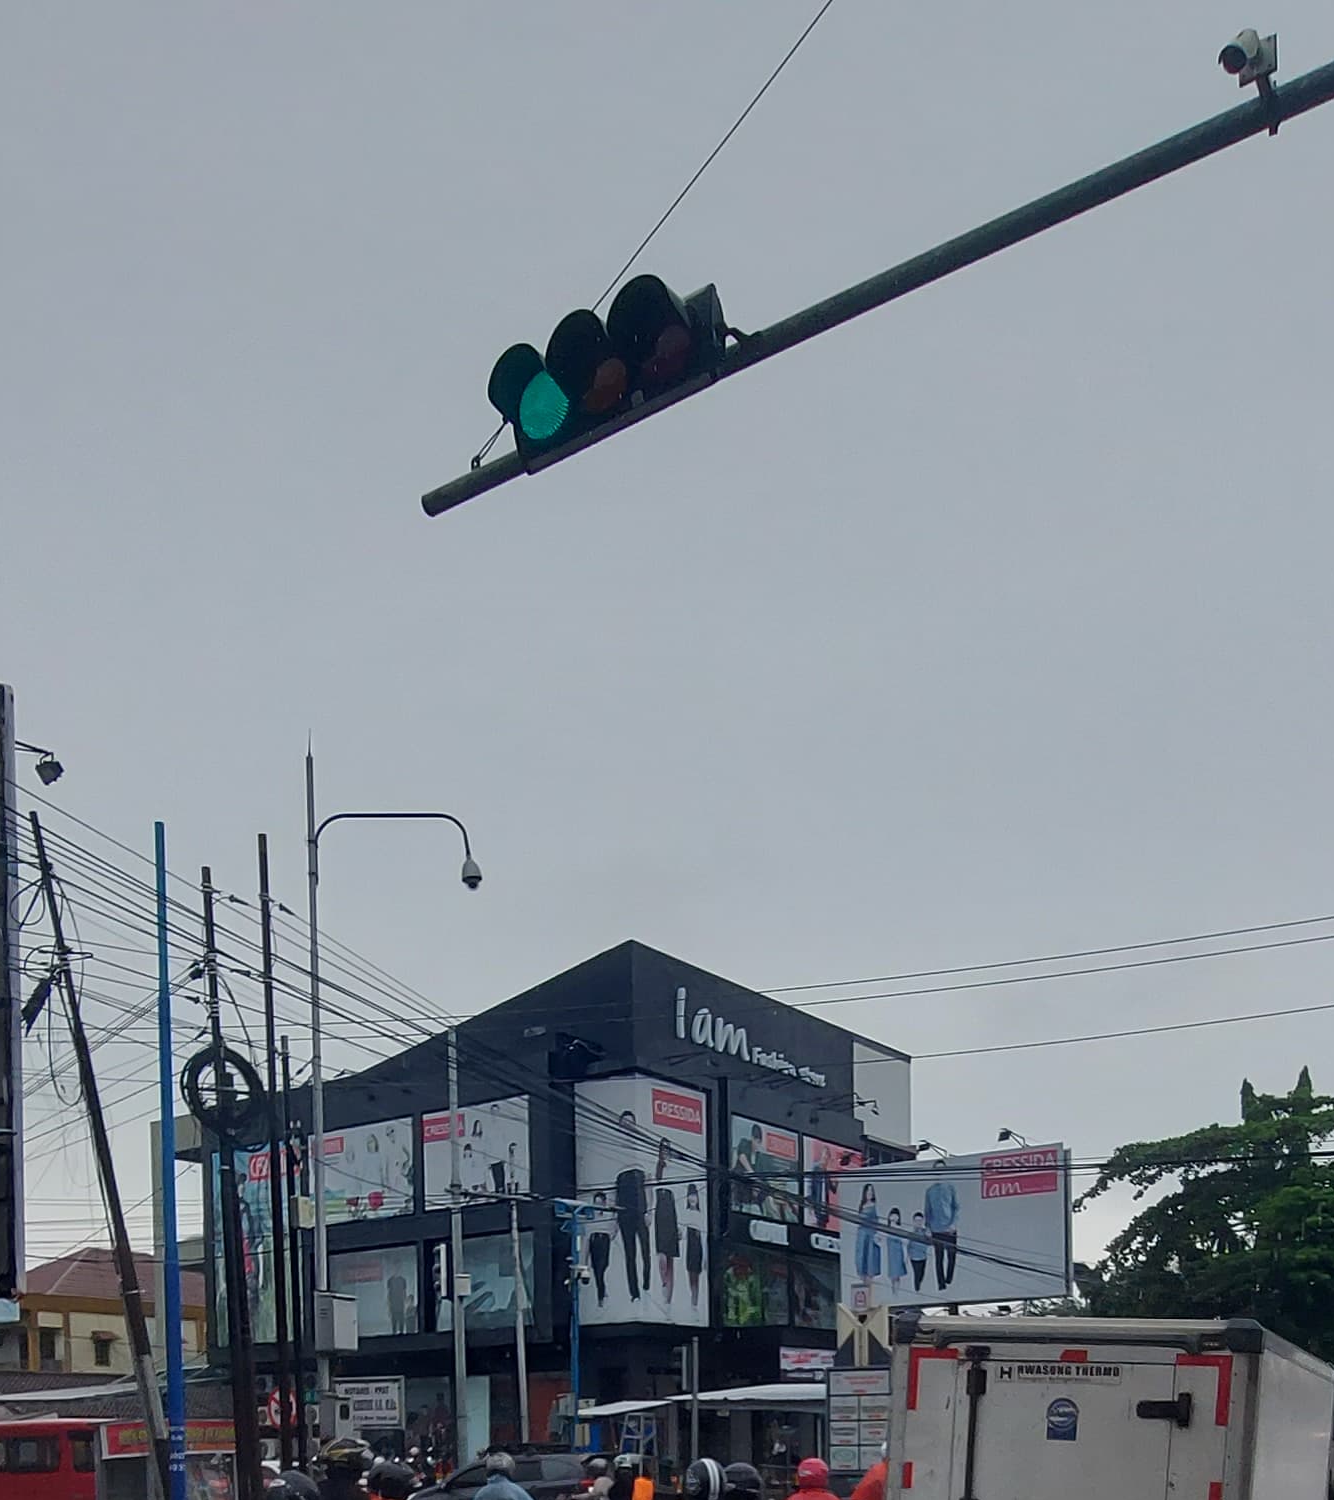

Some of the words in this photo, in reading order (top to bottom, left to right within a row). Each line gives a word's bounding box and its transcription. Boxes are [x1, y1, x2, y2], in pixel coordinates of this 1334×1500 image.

[691, 1007, 750, 1061] am
[654, 1099, 700, 1126] CRESSIDA
[1075, 1366, 1120, 1377] THERMO
